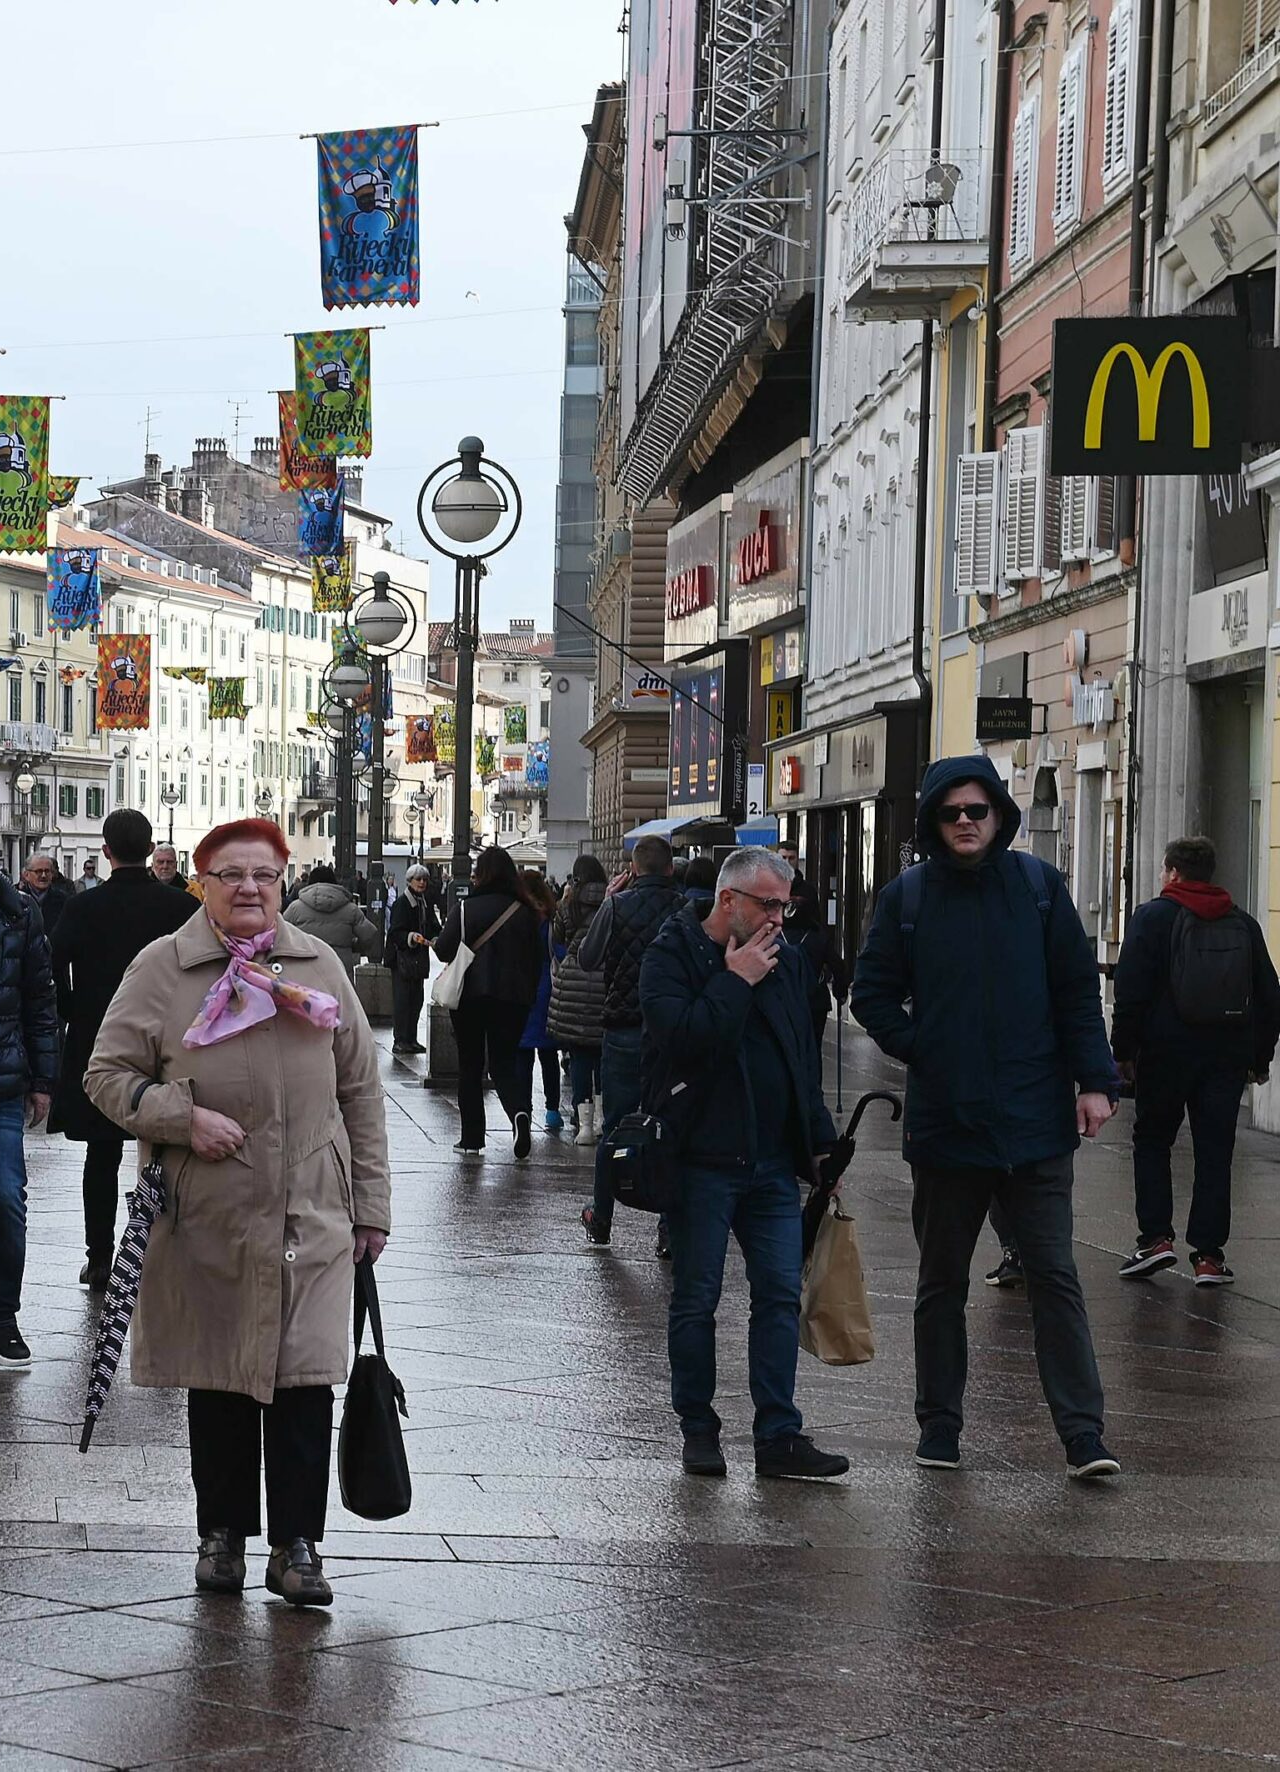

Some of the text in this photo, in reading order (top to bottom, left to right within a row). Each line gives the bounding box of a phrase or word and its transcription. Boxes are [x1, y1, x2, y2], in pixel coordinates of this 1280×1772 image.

[666, 565, 703, 621] ROBNA
[637, 673, 665, 690] dm
[992, 708, 1017, 717] JAVNI
